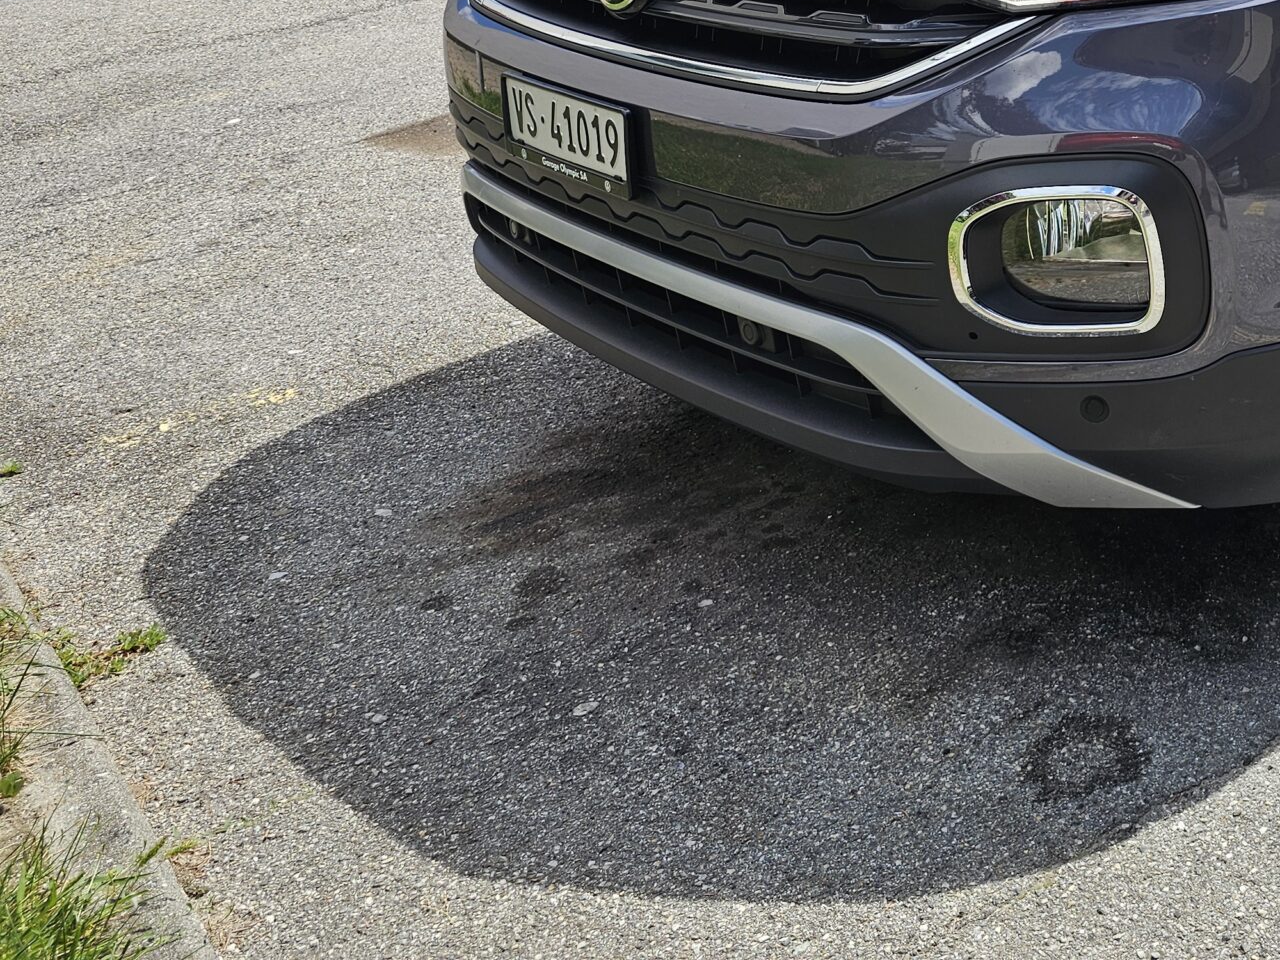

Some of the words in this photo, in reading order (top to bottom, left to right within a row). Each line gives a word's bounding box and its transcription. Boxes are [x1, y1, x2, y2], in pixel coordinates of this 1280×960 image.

[541, 156, 559, 171] Garage
[560, 163, 580, 179] Olympic
[580, 170, 588, 181] SA
